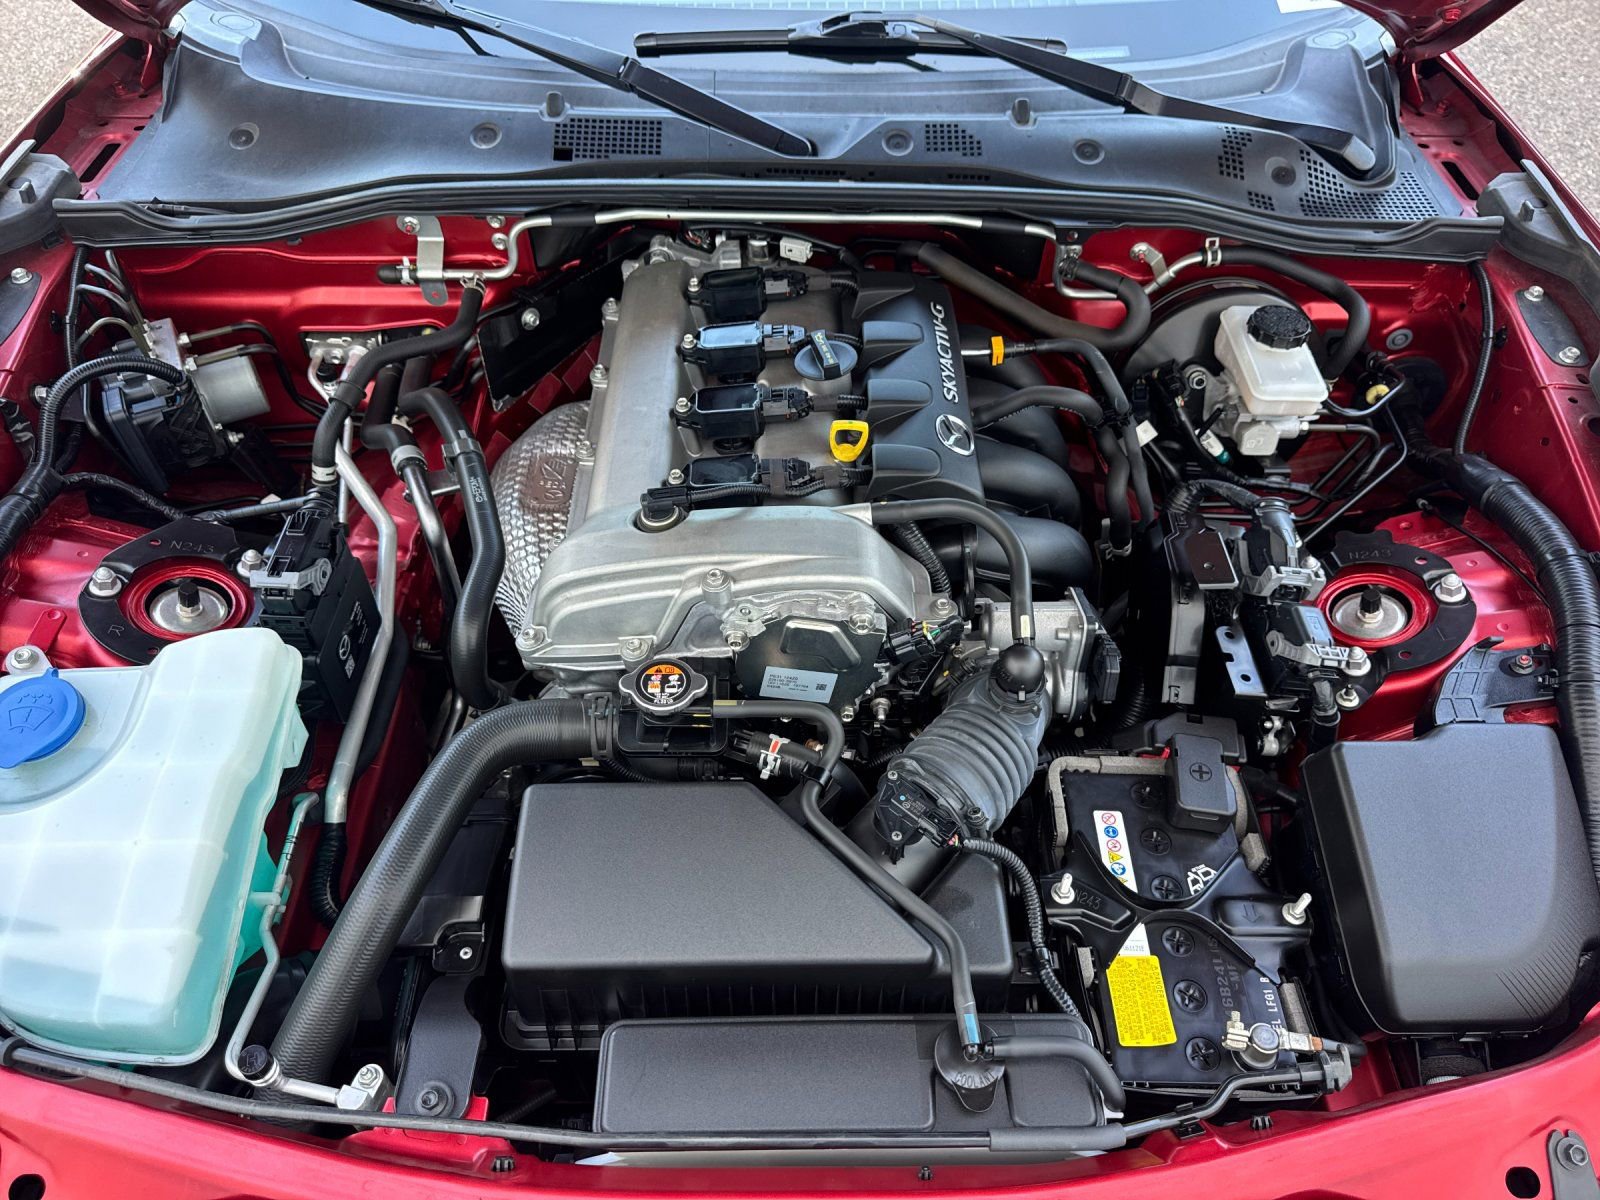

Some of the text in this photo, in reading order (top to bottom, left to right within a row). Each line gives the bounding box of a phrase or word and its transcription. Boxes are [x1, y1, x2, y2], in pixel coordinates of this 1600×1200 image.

[930, 302, 959, 404] SKYACTIV-G
[169, 540, 215, 554] N243
[1348, 549, 1392, 560] N243
[107, 624, 125, 637] R
[955, 1070, 995, 1087] COOLANT
